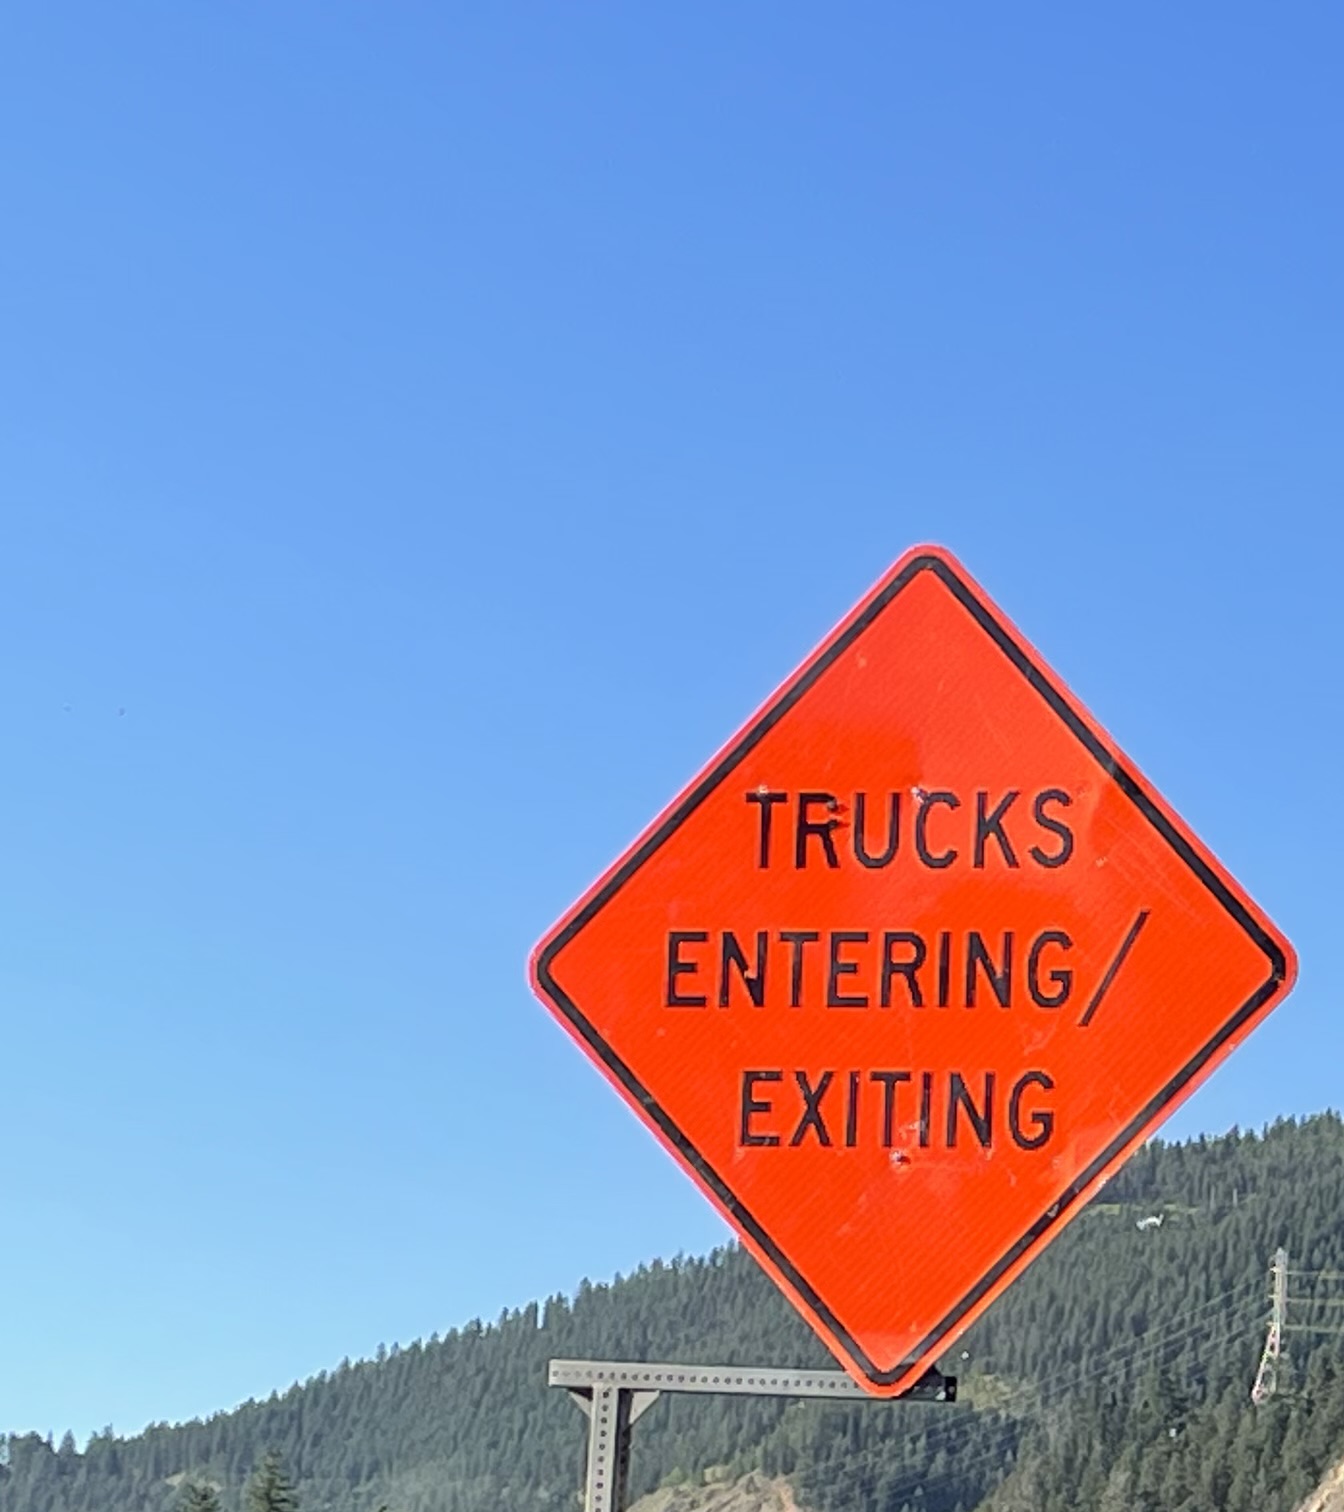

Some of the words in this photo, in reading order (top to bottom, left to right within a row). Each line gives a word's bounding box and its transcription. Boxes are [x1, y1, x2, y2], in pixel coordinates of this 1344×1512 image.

[745, 788, 1075, 869] TRUCKS
[666, 910, 1150, 1027] ENTERING/
[739, 1070, 1055, 1151] EXITING
